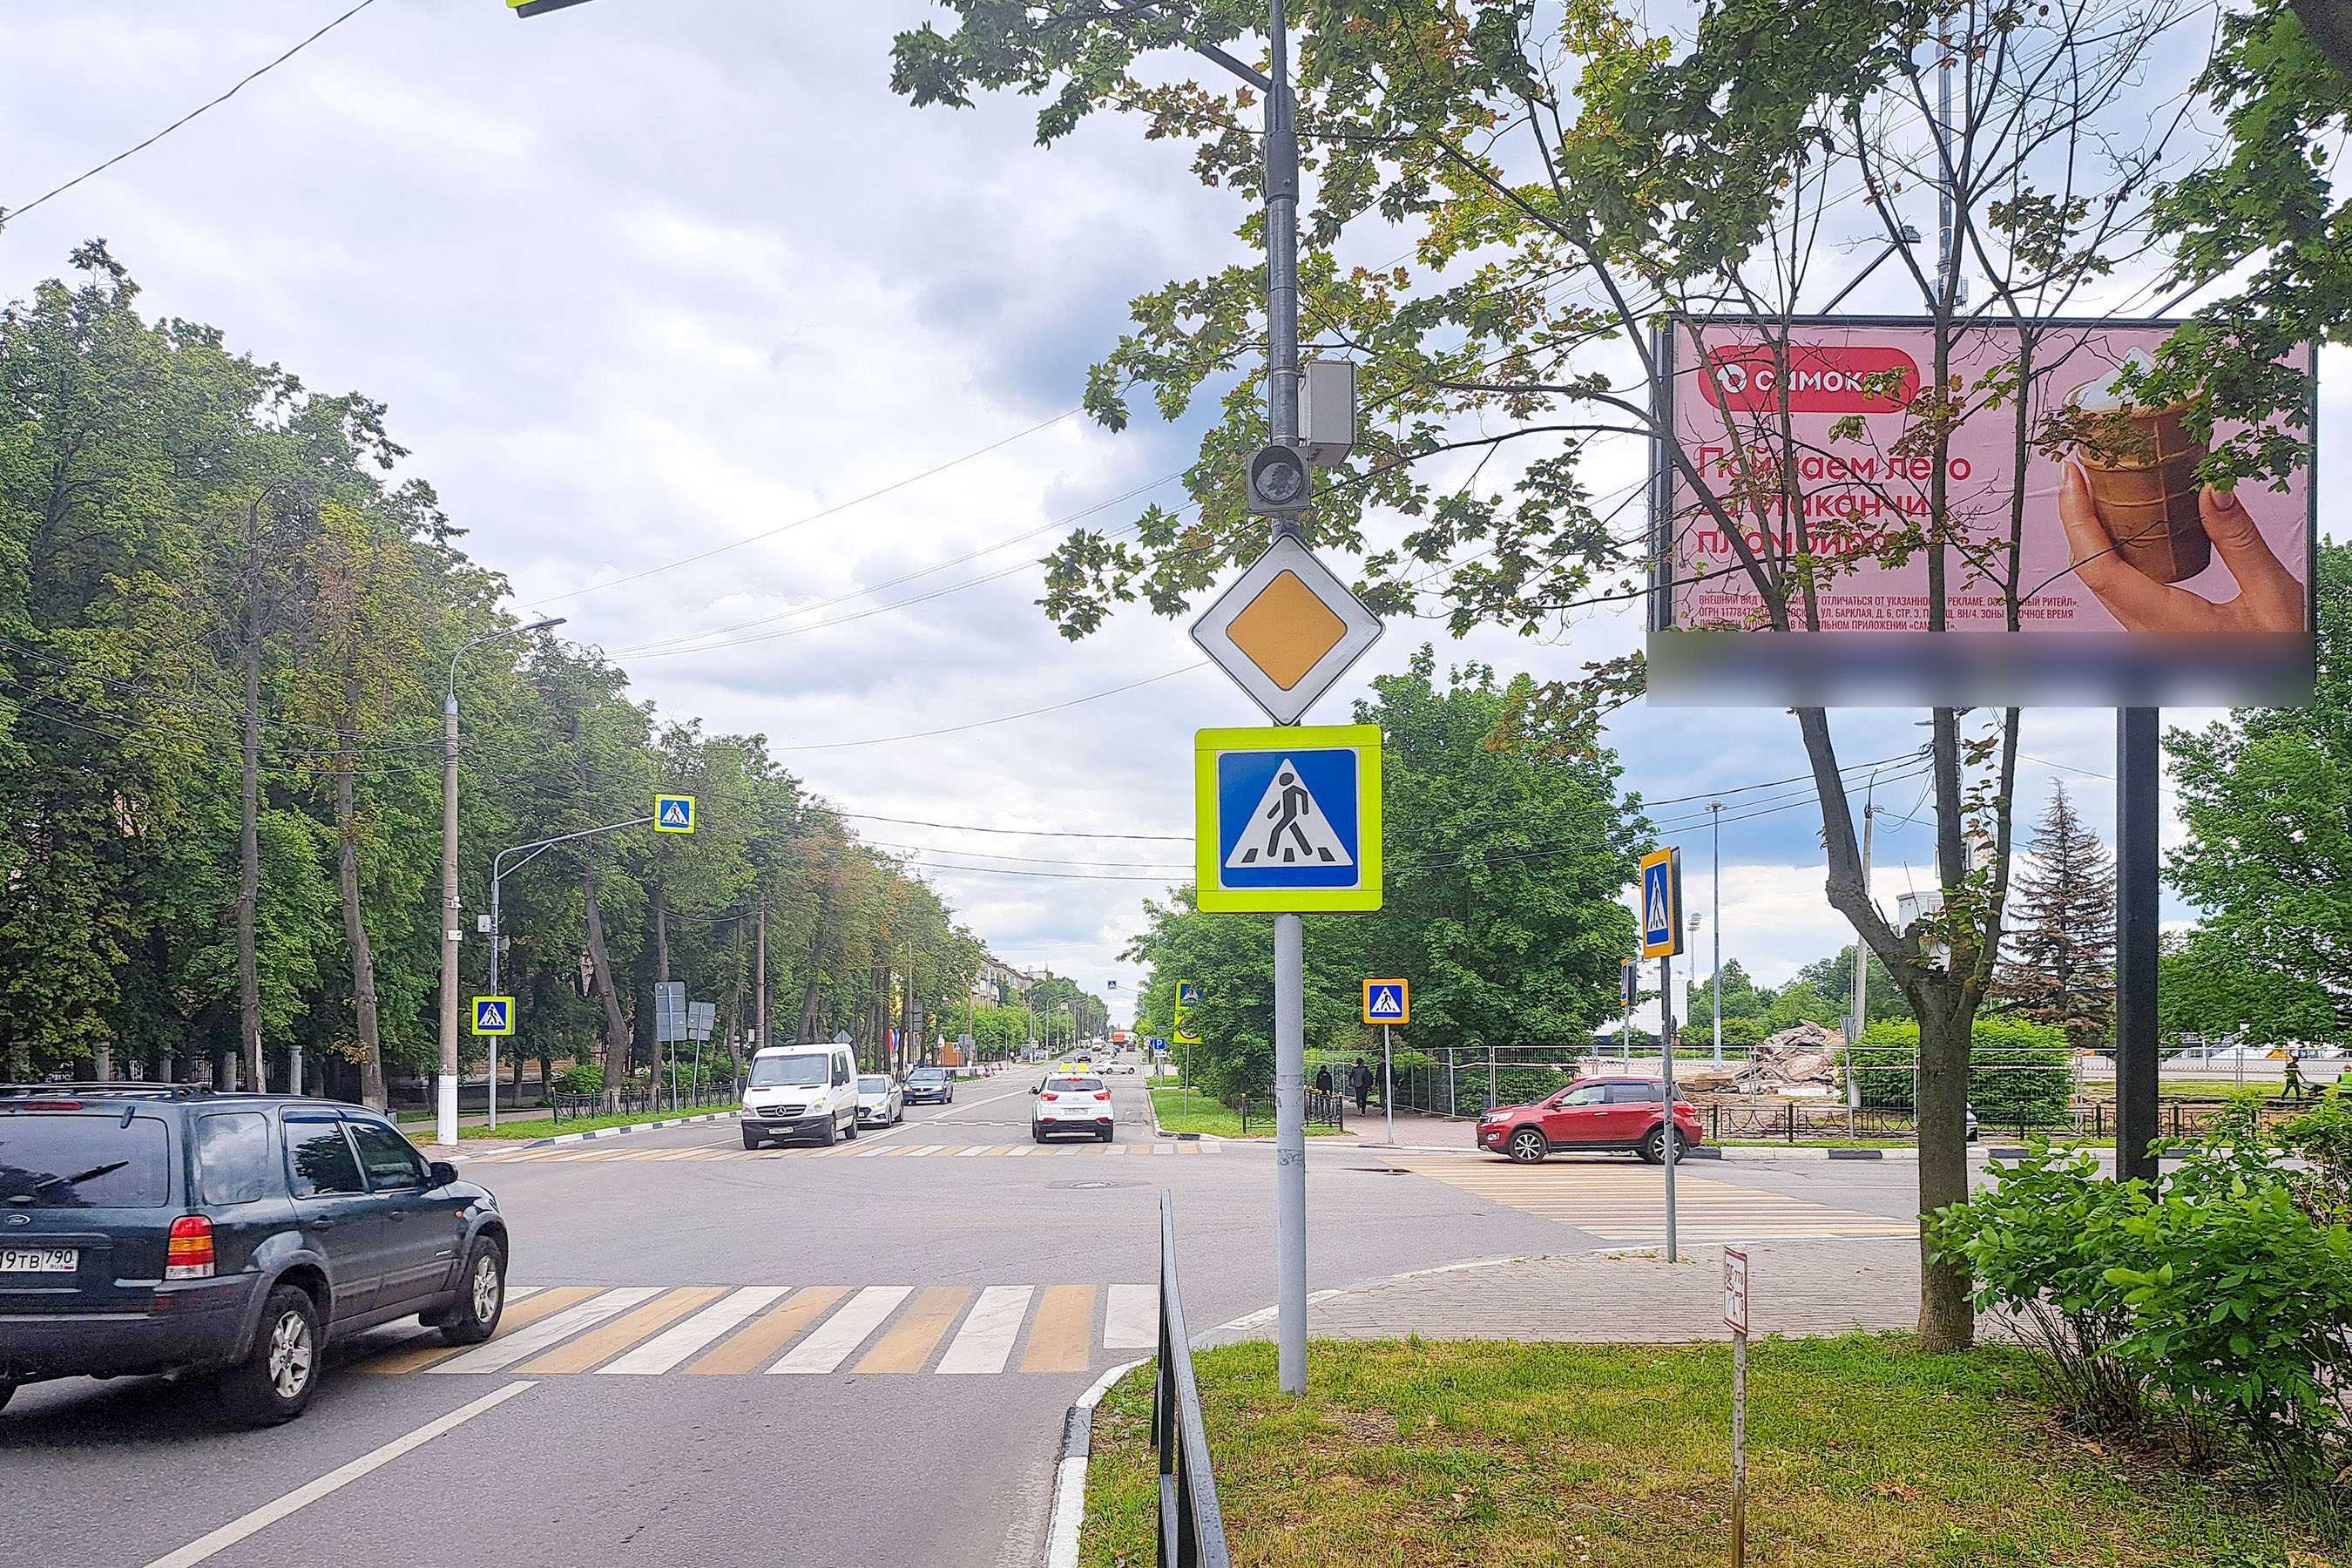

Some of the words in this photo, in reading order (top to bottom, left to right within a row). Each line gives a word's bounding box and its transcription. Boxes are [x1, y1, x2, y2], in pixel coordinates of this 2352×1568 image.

[1885, 457, 1970, 480] лео
[1821, 596, 1873, 605] ОТЛИЧАТЬСЯ
[1875, 596, 1885, 605] ОТ
[1887, 596, 1930, 607] УКАЗАННО
[1699, 607, 1719, 617] ОГРН
[1821, 608, 1834, 618] УЛ.
[1835, 608, 1874, 618] БАРКЛАЯ,
[1980, 609, 2004, 618] ЗОНЫ
[2018, 609, 2044, 618] ОЧНОЕ
[2047, 610, 2073, 618] ВРЕМЯ
[1851, 620, 1908, 630] ПРИЛОЖЕНИИ
